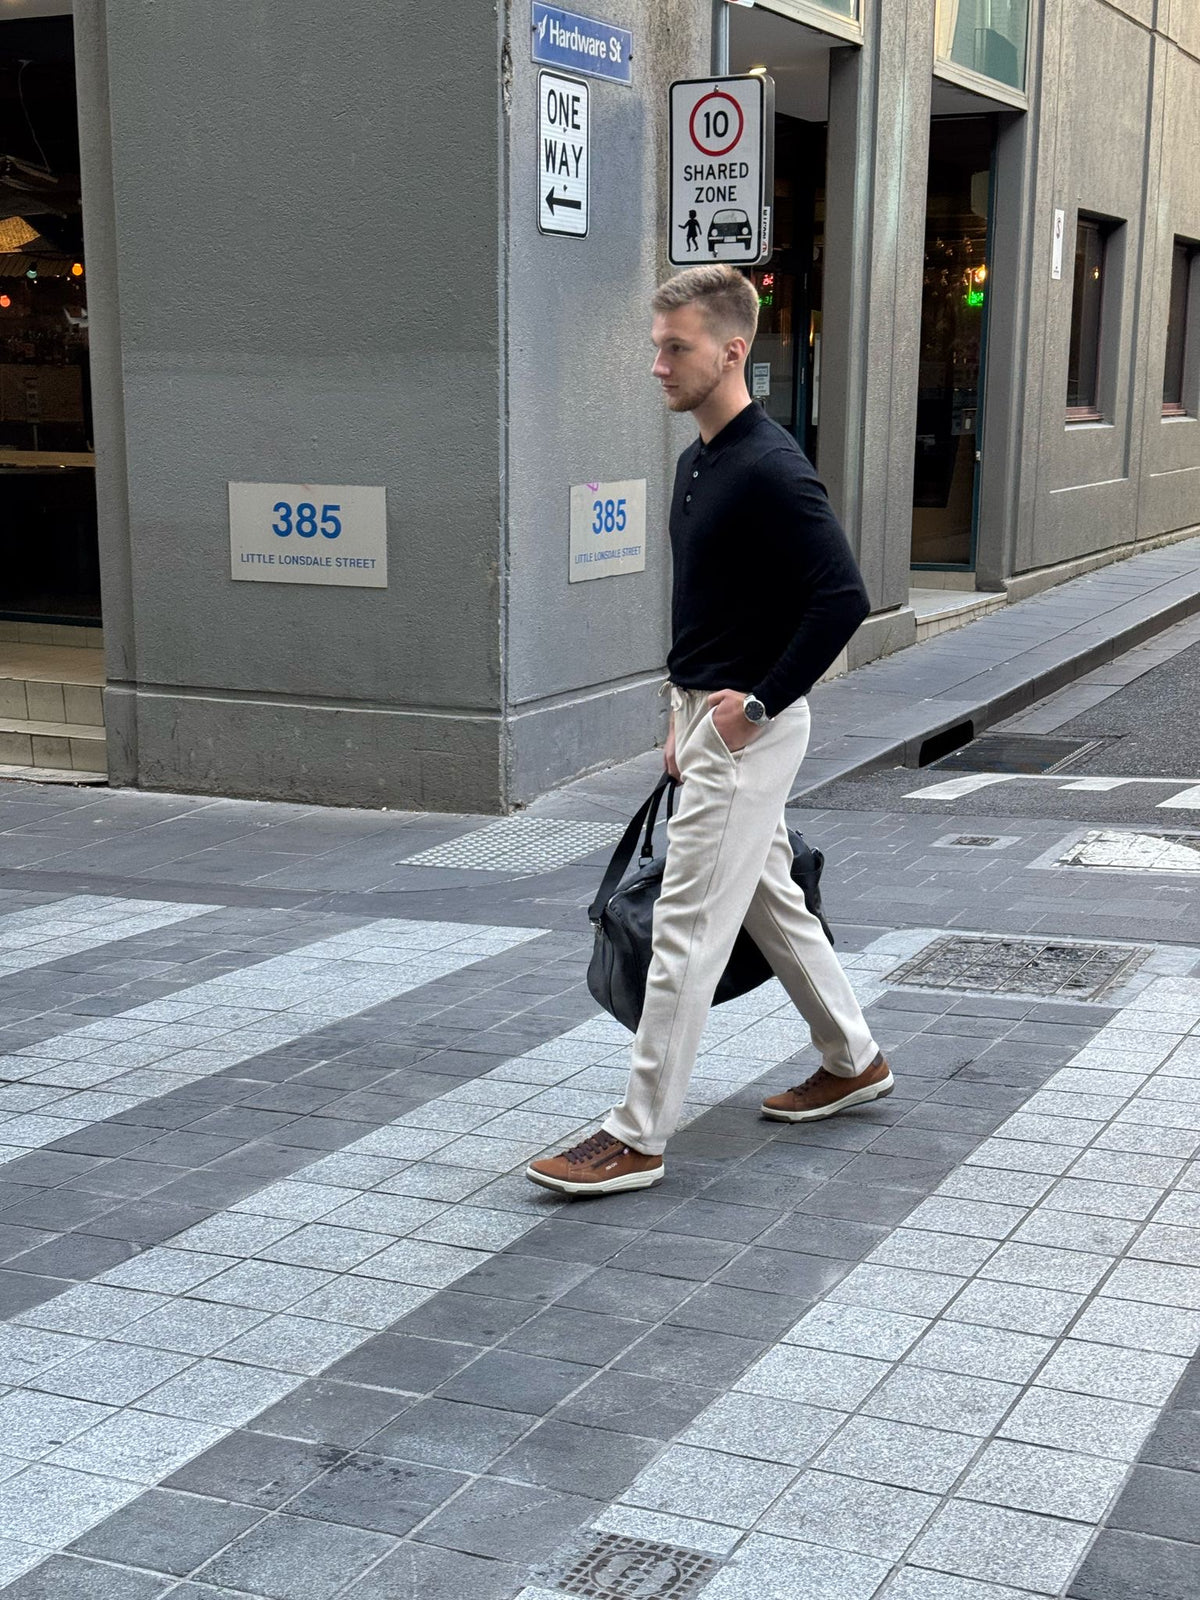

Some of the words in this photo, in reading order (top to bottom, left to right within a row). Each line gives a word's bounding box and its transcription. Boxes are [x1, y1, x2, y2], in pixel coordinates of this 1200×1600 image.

[549, 18, 607, 59] Hardware
[609, 37, 622, 63] St
[547, 88, 581, 130] ONE
[703, 110, 729, 139] 10
[544, 138, 583, 179] WAY
[683, 162, 750, 182] SHARED
[694, 185, 738, 204] ZONE
[272, 501, 342, 539] 385
[592, 498, 627, 535] 385
[240, 553, 275, 565] LITTLE
[278, 554, 333, 567] LONSDALE
[335, 557, 377, 569] STREET
[575, 552, 593, 564] LITTLE
[594, 548, 621, 562] LONSDALE
[622, 545, 642, 557] STREET
